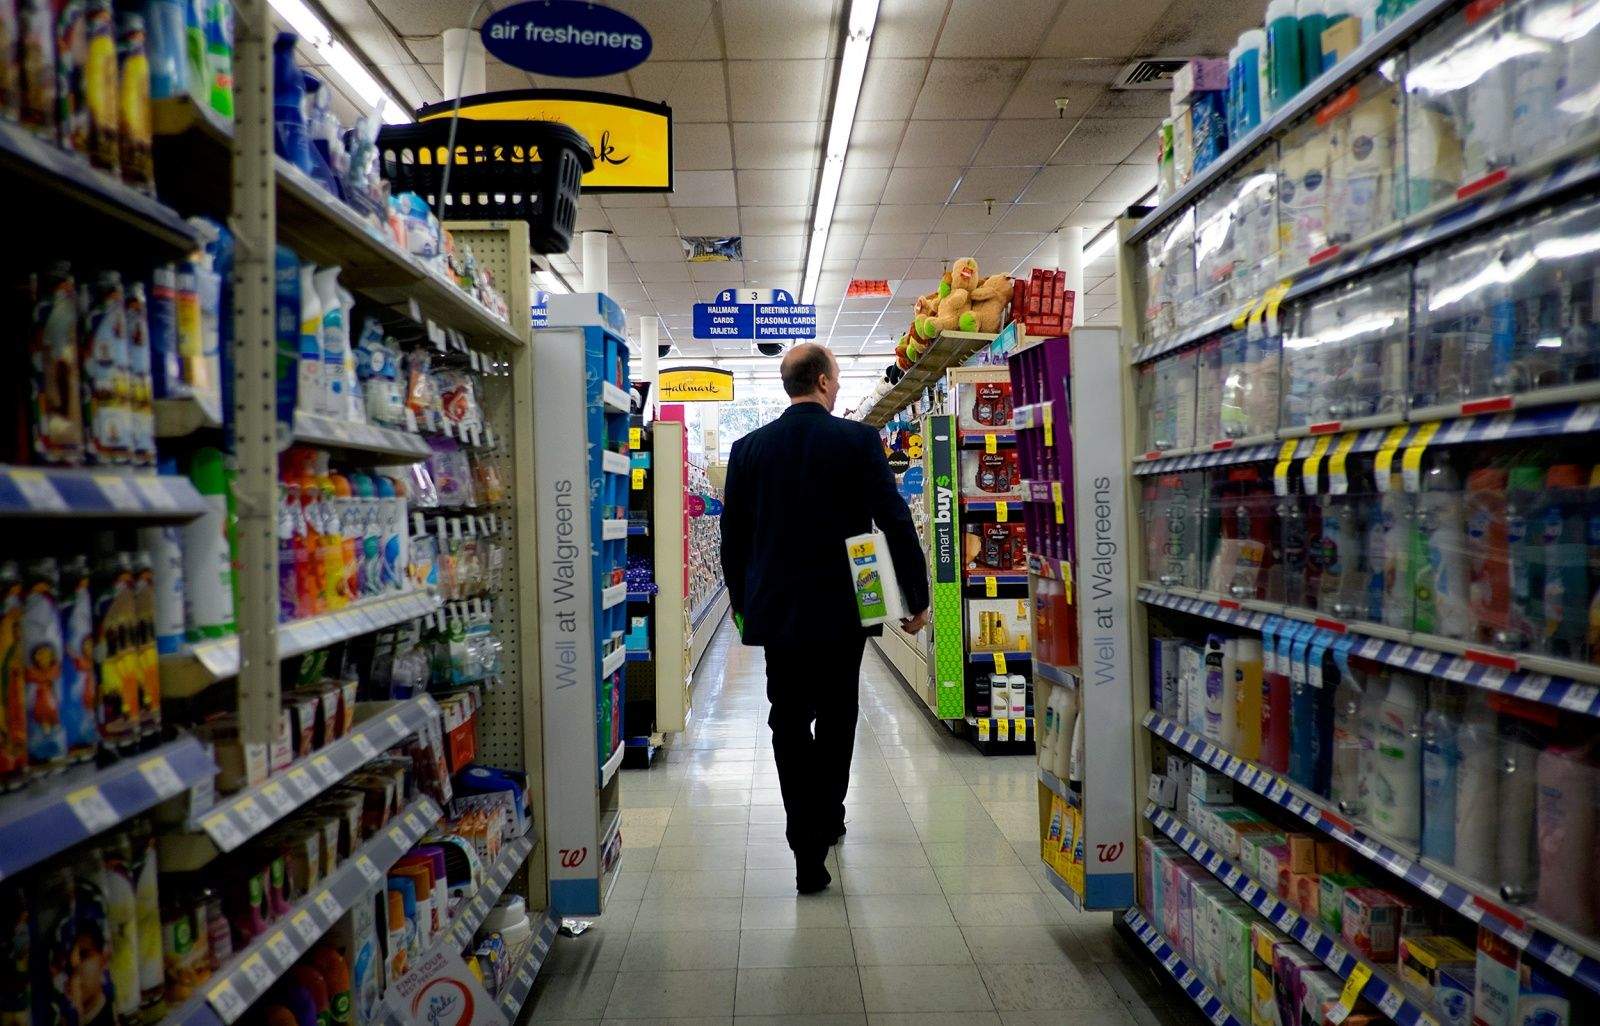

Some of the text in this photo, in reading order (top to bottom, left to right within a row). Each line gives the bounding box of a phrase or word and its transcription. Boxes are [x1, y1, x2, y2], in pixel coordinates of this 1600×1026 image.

[490, 21, 643, 50] air fresheners
[722, 292, 731, 302] B
[751, 292, 758, 301] 3
[777, 292, 787, 302] A
[707, 306, 739, 314] HALLMARK
[760, 306, 809, 314] GREETING CARDS
[756, 317, 815, 325] SEASONAL CARDS
[709, 327, 739, 335] TARJETAS
[760, 327, 811, 335] PAPEL DE REGALO
[661, 381, 720, 397] Hallmark
[938, 527, 950, 563] smart
[552, 479, 579, 690] Well at Walgreens
[1091, 476, 1117, 686] Well at Walgreens
